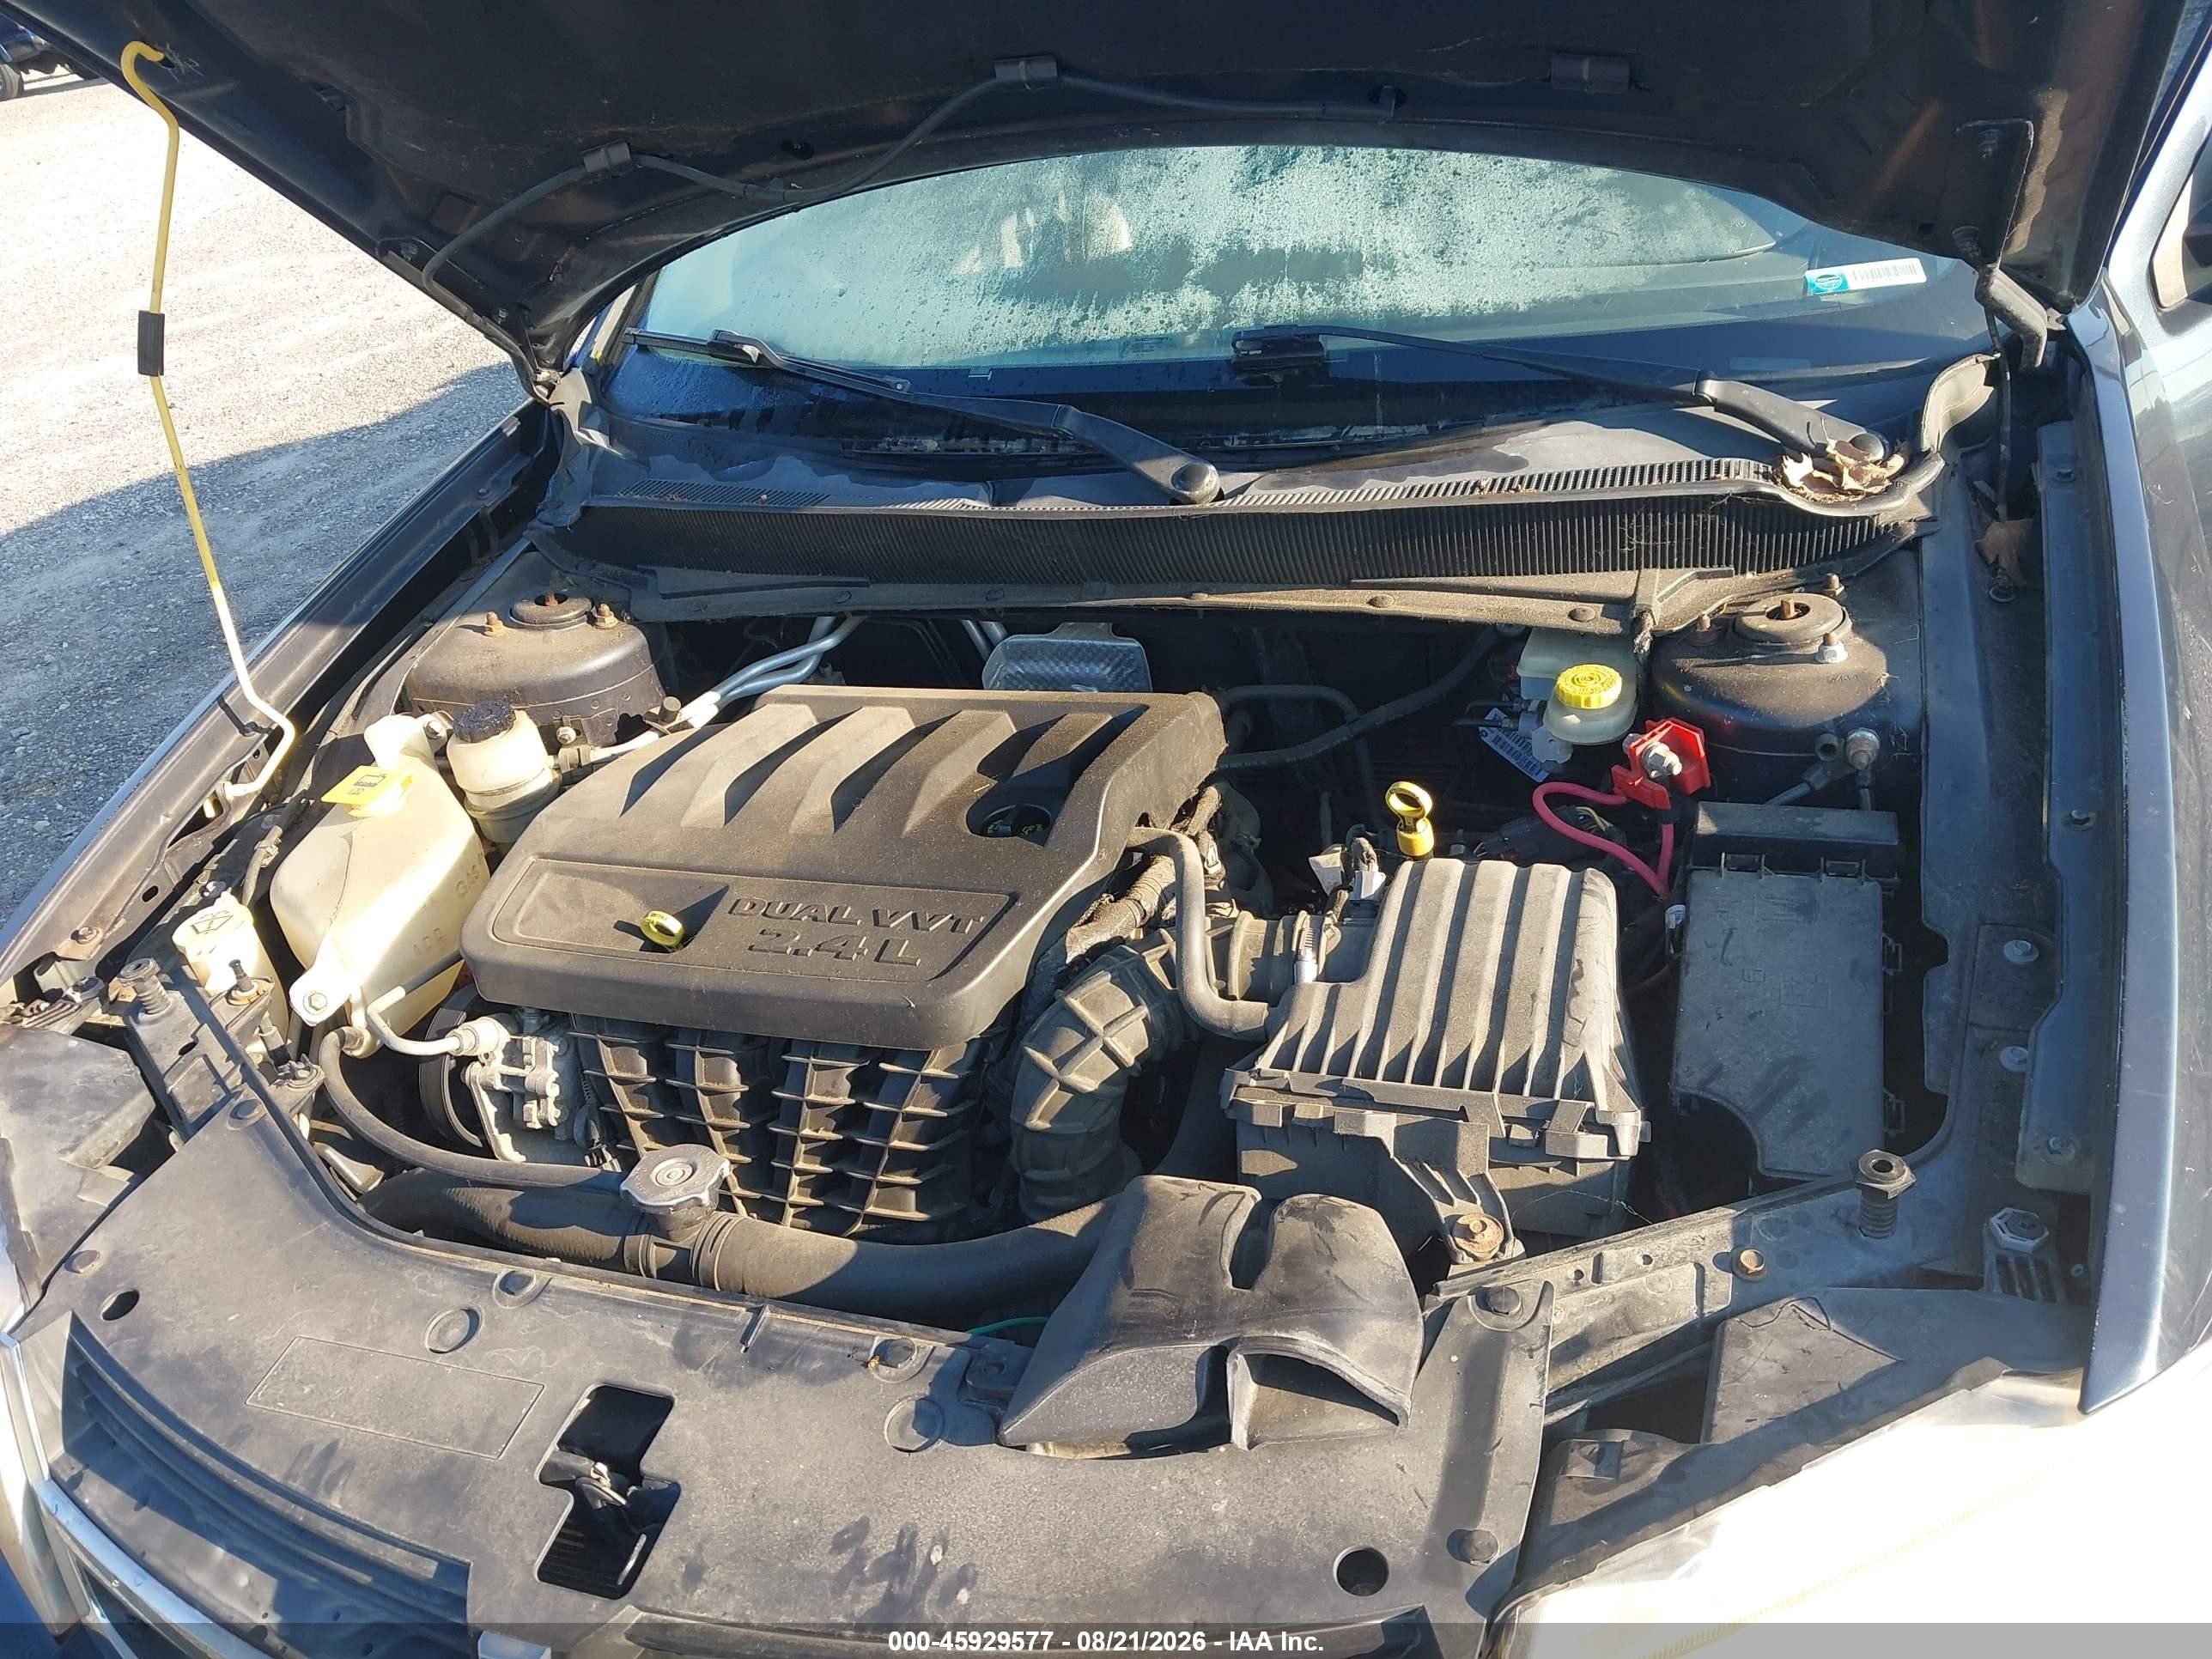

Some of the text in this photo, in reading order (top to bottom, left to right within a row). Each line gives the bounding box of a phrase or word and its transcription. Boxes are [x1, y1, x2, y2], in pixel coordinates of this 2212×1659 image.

[727, 897, 985, 935] DUAL VVT
[747, 927, 921, 968] 2.4L
